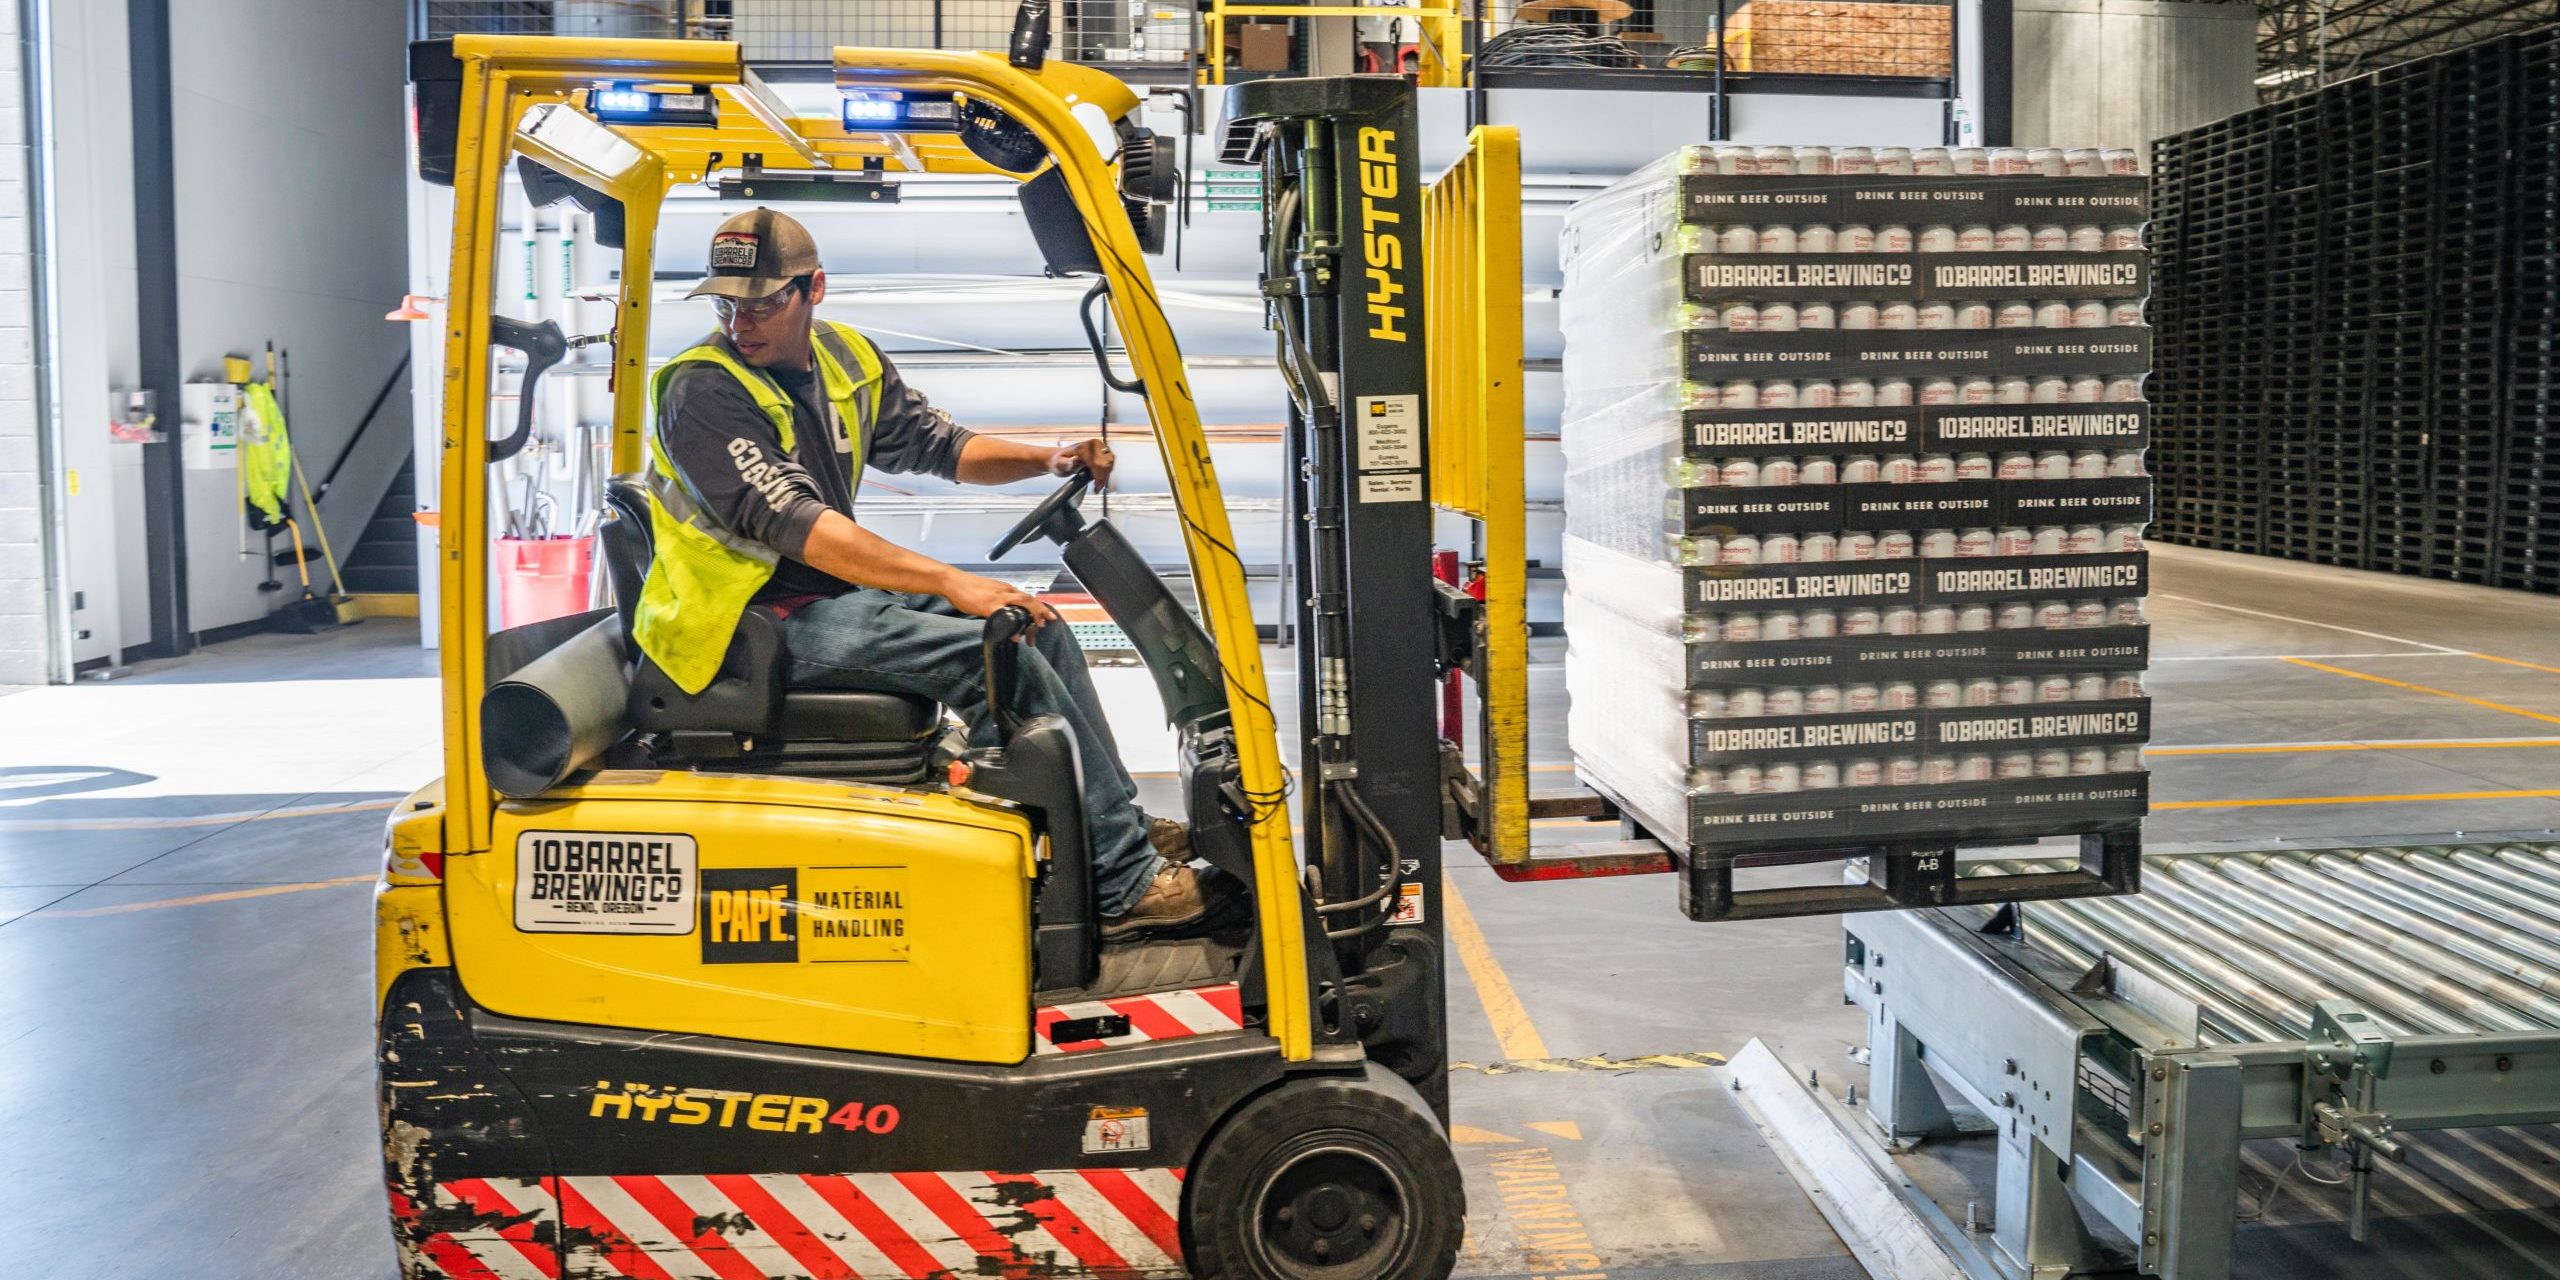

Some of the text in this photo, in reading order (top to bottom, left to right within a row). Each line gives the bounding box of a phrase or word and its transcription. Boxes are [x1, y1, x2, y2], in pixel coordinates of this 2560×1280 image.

[1694, 194, 1828, 204] DRINK BEER OUTSIDE
[1855, 191, 1985, 201] DRINK BEER OUTSIDE
[2015, 196, 2139, 206] DRINK BEER OUTSIDE
[1358, 126, 1407, 343] HYSTER
[1860, 350, 1989, 361] DRINK BEER OUTSIDE
[2015, 344, 2139, 355] DRINK BEER OUTSIDE
[1698, 351, 1831, 363] DRINK BEER OUTSIDE
[1697, 501, 1830, 515] DRINK BEER OUTSIDE
[1861, 499, 1989, 512] DRINK BEER OUTSIDE
[2017, 496, 2141, 508] DRINK BEER OUTSIDE
[1859, 647, 1987, 661] DRINK BEER OUTSIDE
[2016, 646, 2139, 660] DRINK BEER OUTSIDE
[1700, 655, 1833, 670] DRINK BEER OUTSIDE
[2015, 788, 2137, 804] DRINK BEER OUTSIDE
[1861, 797, 1987, 813] DRINK BEER OUTSIDE
[1703, 810, 1834, 825] DRINK BEER OUTSIDE
[1917, 858, 1940, 872] A-B
[814, 891, 904, 911] MATERIAL
[813, 918, 904, 939] HANDLING
[589, 1080, 900, 1135] HYSTER 40
